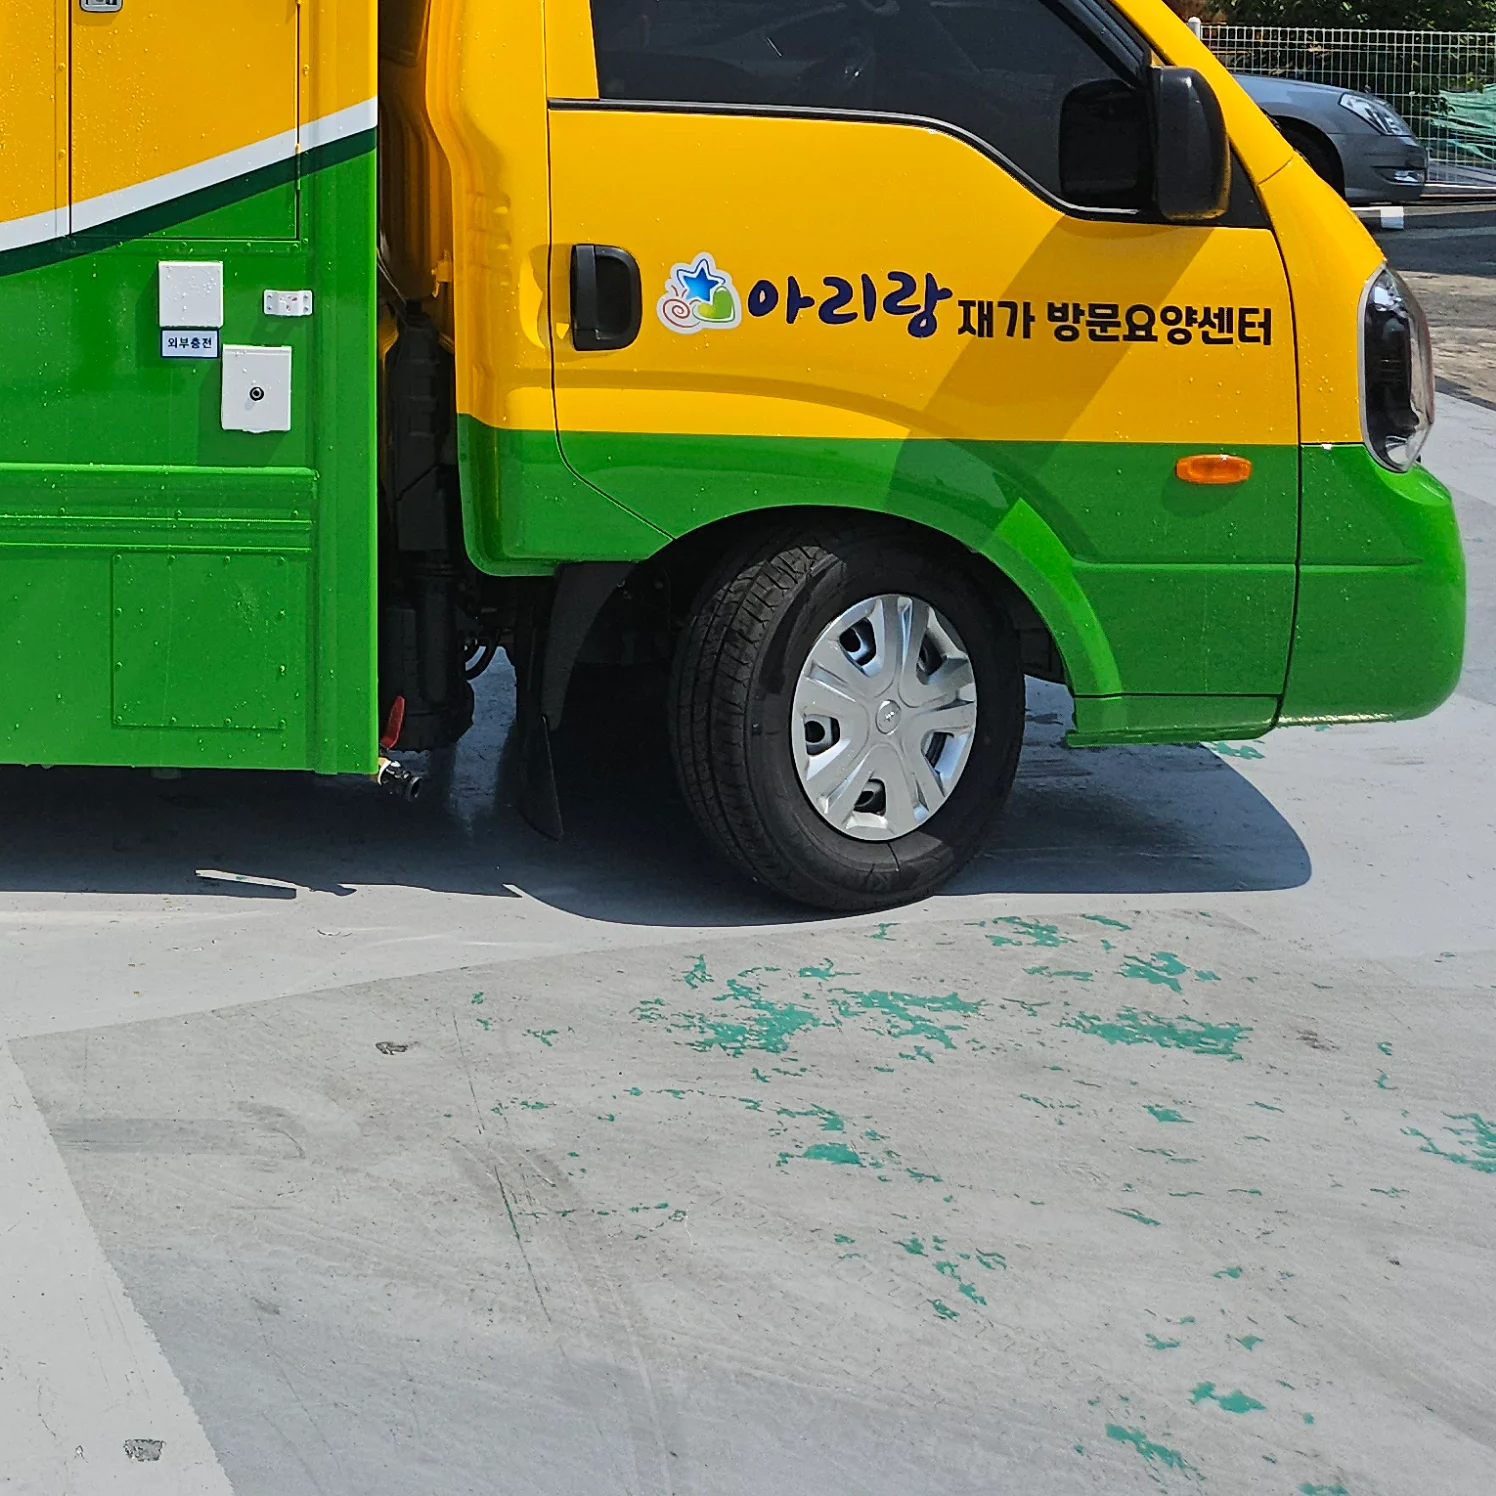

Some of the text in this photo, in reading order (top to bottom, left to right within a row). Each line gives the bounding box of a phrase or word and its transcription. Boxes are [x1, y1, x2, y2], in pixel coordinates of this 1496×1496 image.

[747, 270, 1272, 346] 아리랑 재가 방문요양센터
[167, 337, 213, 350] 외부충전
